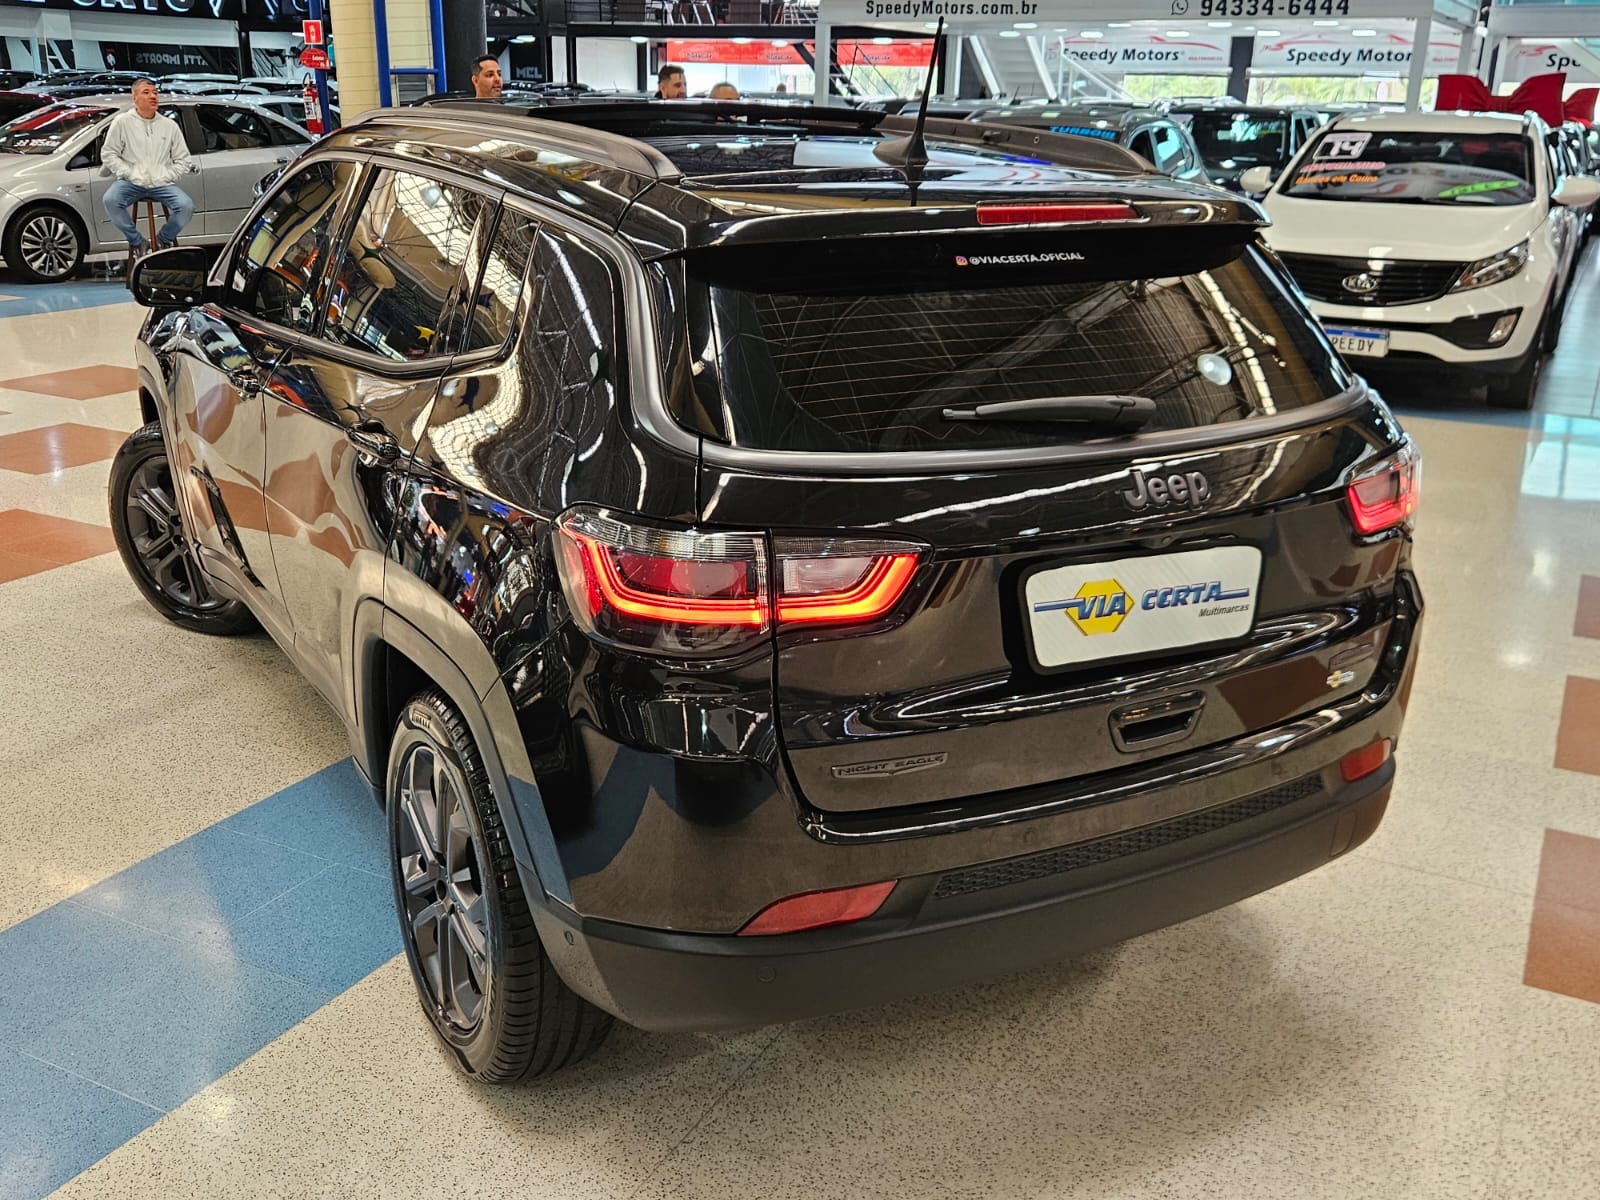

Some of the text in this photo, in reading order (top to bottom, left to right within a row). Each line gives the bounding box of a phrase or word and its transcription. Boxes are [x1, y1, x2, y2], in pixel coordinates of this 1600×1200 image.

[866, 1, 1038, 17] SpeedyMotors.com.br
[1200, 0, 1350, 16] 94334-6444
[1122, 48, 1179, 62] Motors
[1287, 48, 1350, 66] Speedy
[1356, 49, 1413, 63] Motor
[969, 252, 1085, 266] @VIACERTA.OFICIAL
[1123, 470, 1210, 509] Jeep
[1077, 591, 1126, 620] VIA
[1197, 603, 1250, 618] Multimarcas
[838, 762, 889, 776] NIGHT
